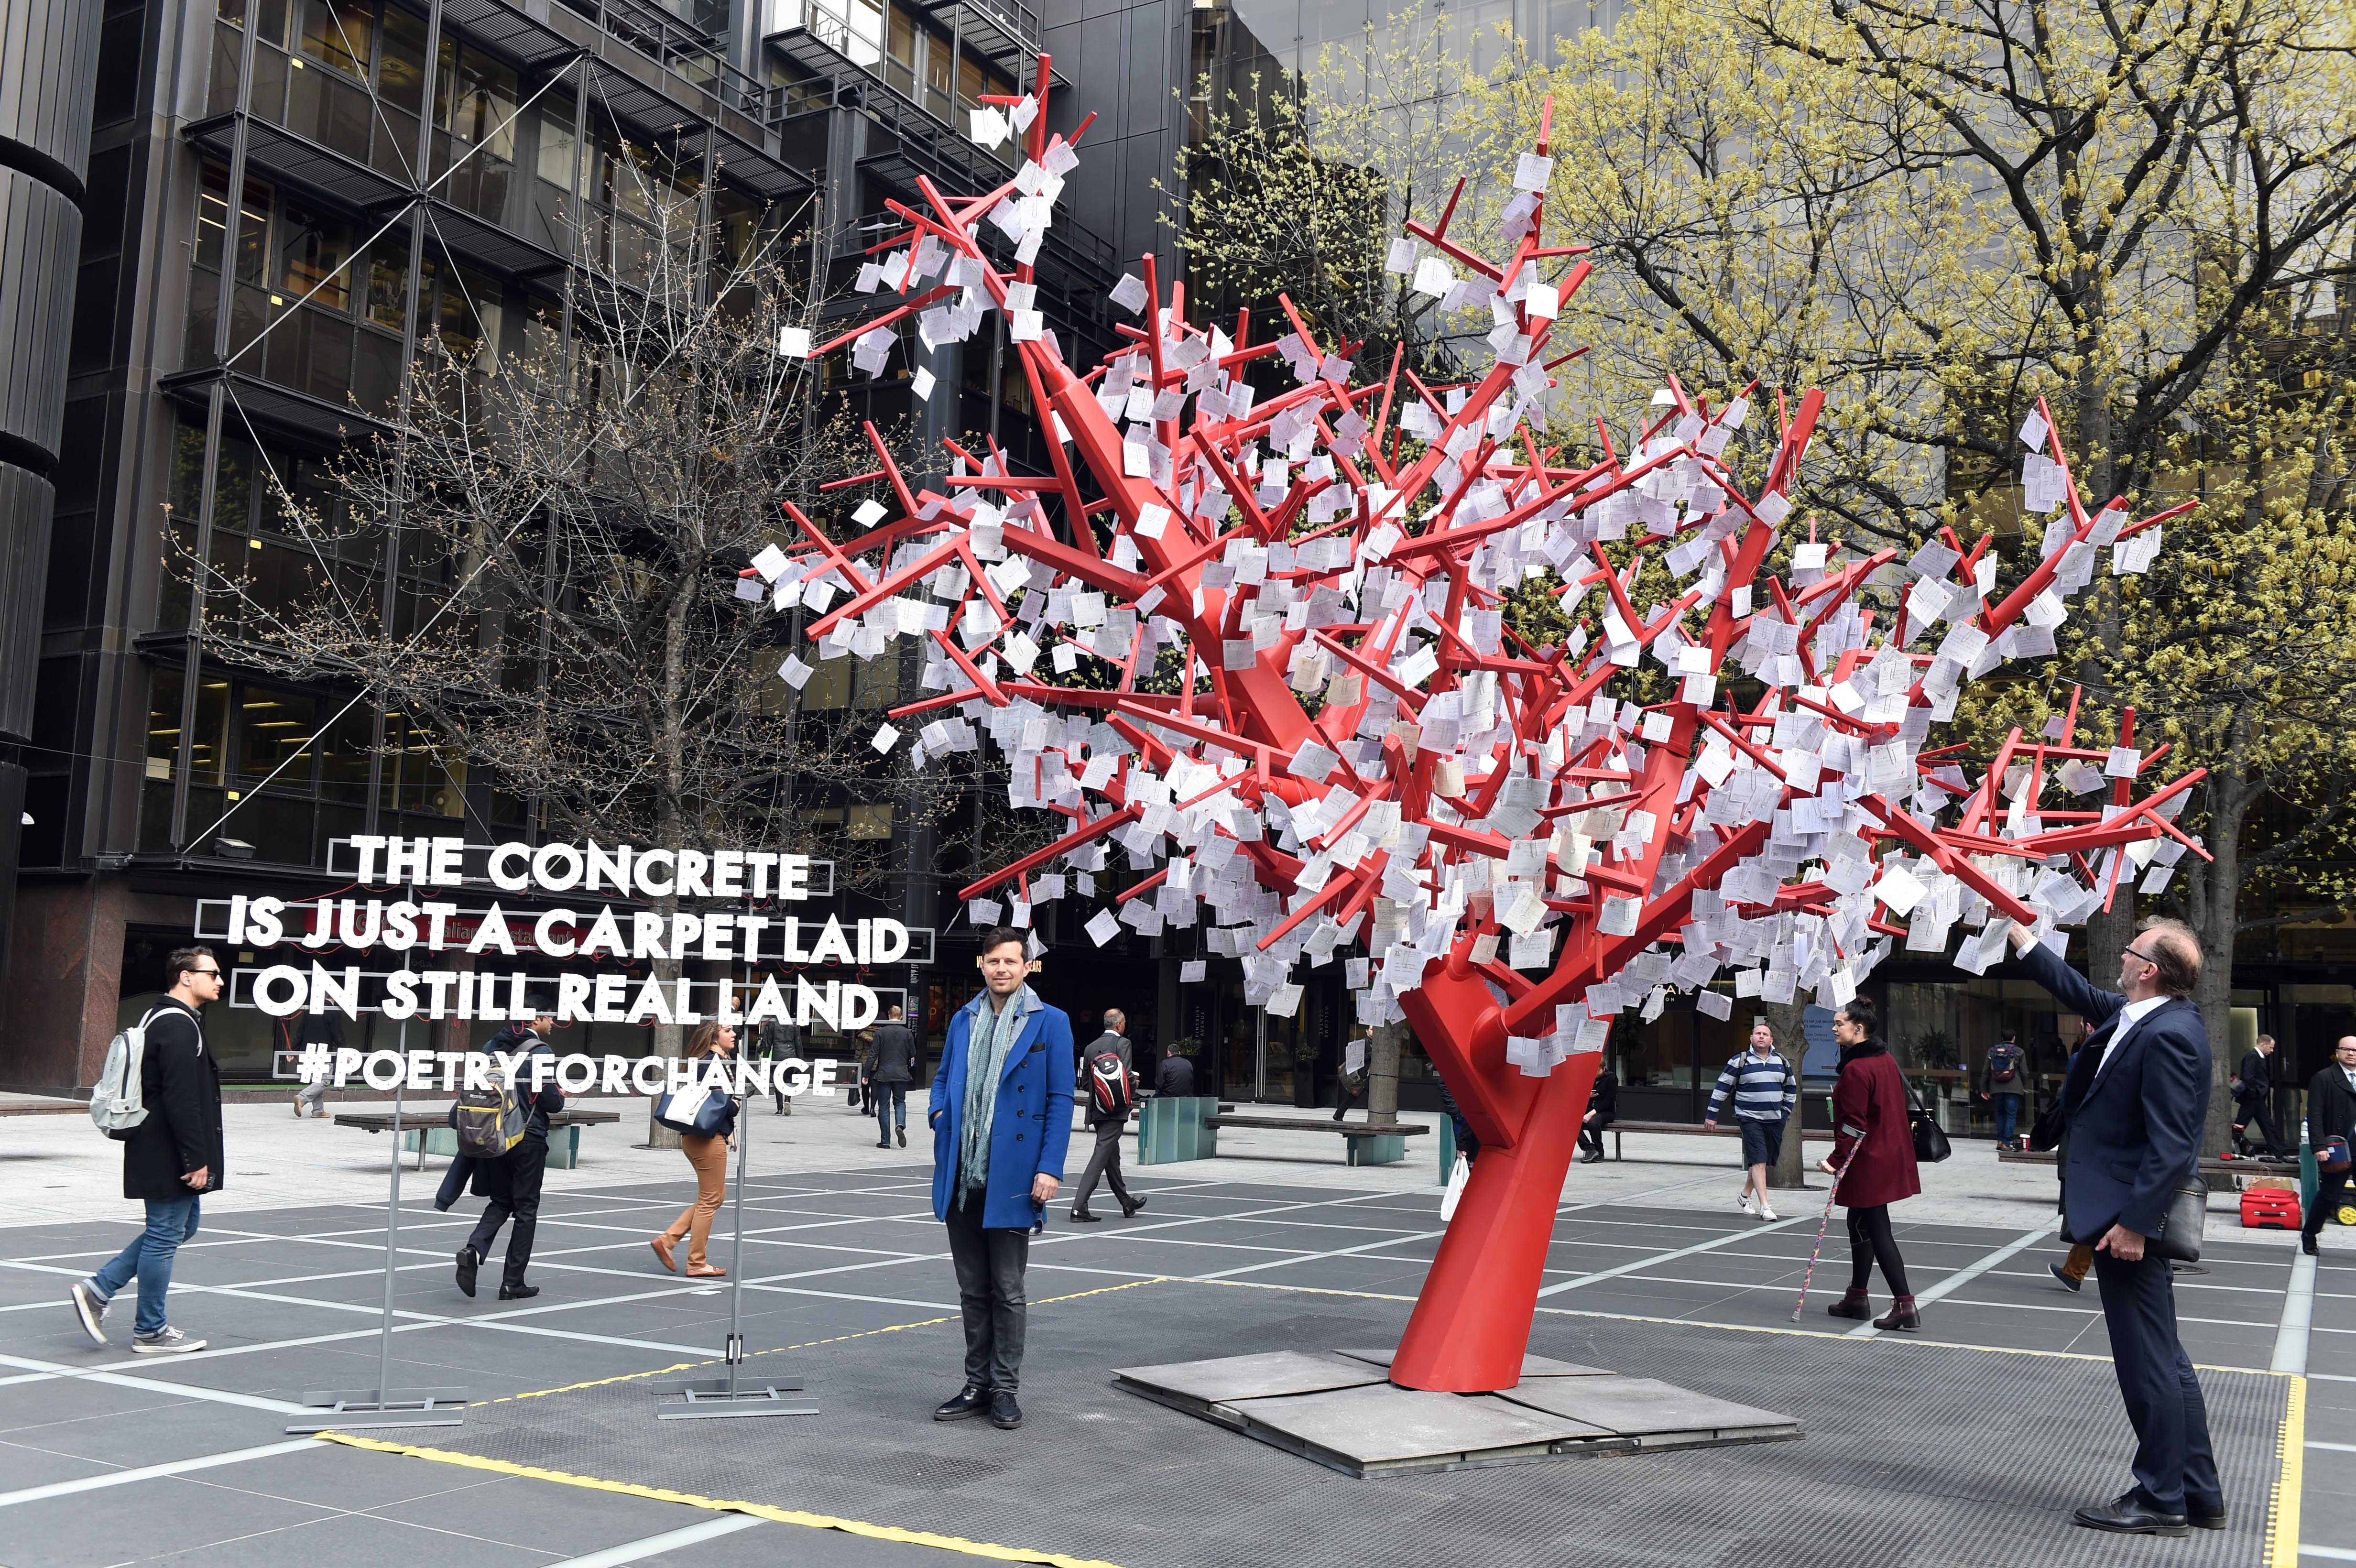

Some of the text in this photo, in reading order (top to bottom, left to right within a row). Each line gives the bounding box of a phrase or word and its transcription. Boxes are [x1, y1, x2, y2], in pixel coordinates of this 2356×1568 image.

[350, 835, 809, 900] THE CONCRETE
[228, 895, 284, 947] IS
[302, 899, 457, 950] JUST
[466, 901, 517, 955] A
[534, 904, 768, 962] CARPET
[784, 913, 909, 964] LAID
[253, 959, 879, 1032] ON STILL REAL LAND
[296, 1043, 838, 1099] #POETRYFORCHANGE
